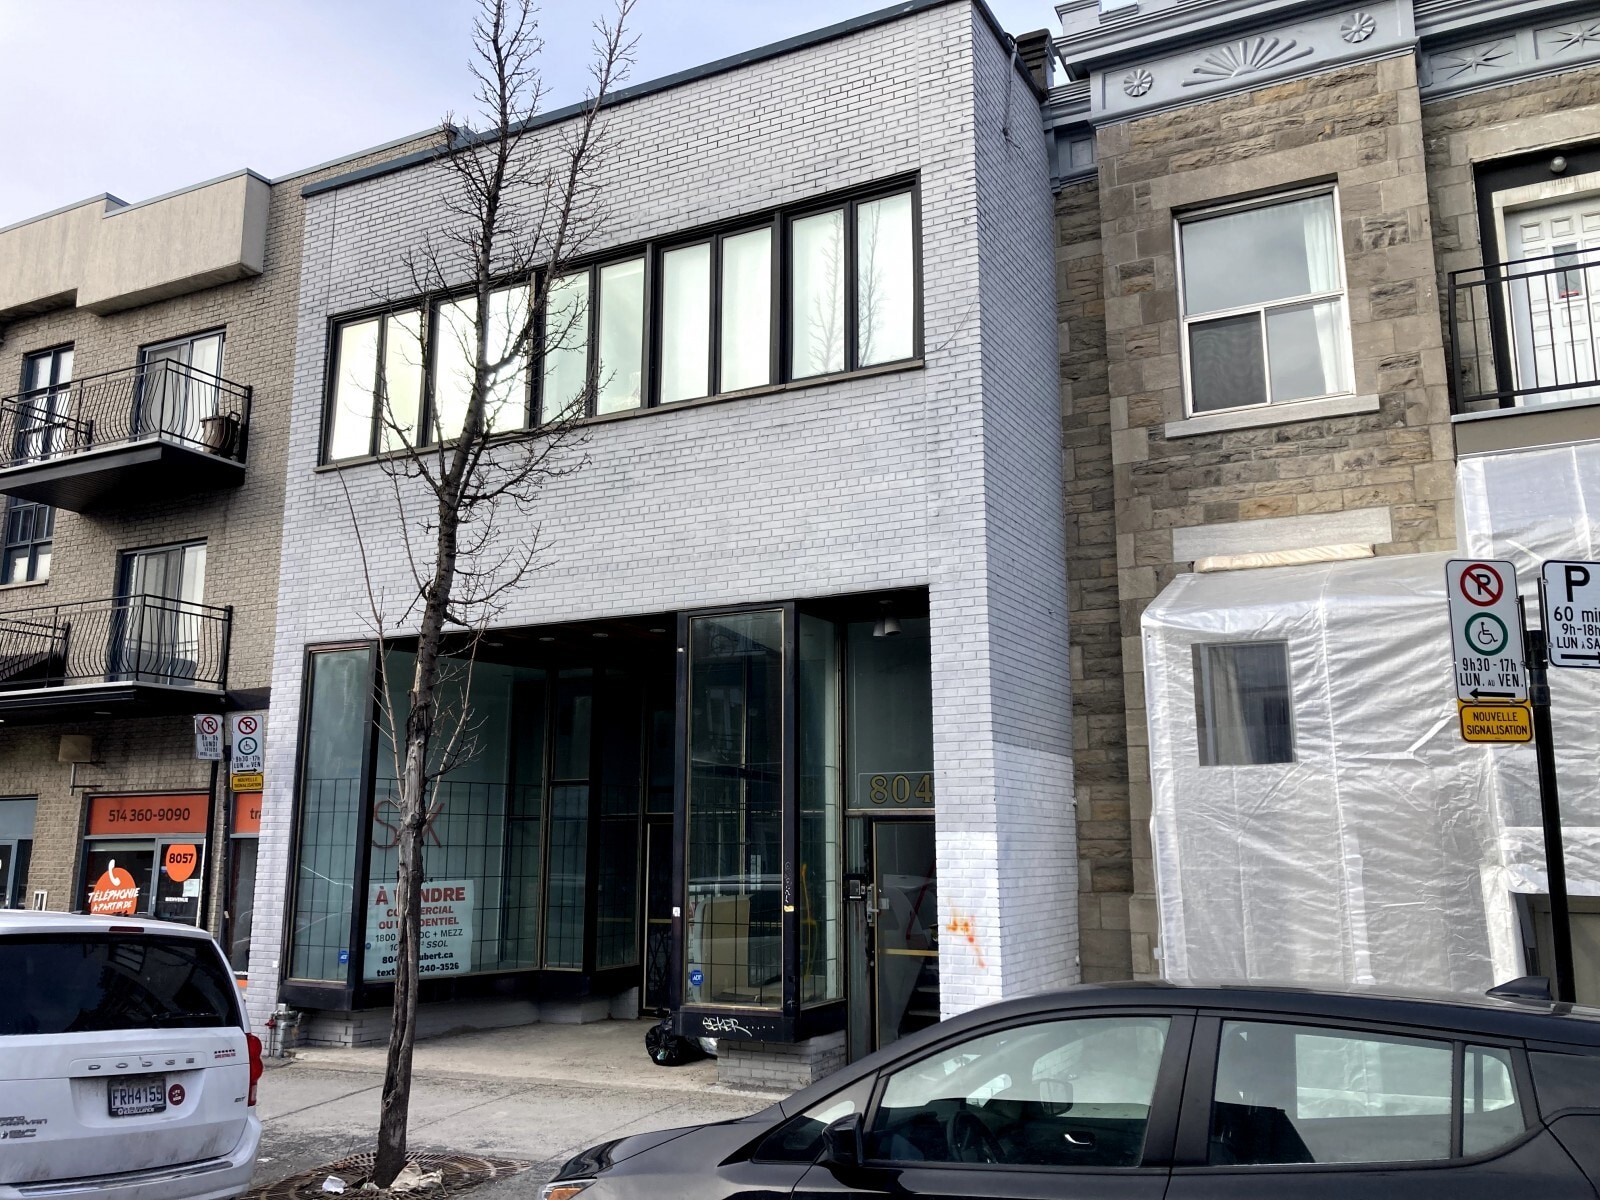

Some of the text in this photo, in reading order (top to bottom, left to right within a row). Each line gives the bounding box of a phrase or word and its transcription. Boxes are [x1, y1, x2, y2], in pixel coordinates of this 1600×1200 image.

[1564, 565, 1590, 602] P
[1554, 606, 1600, 622] 60 mi
[1562, 623, 1600, 636] 9h-18h
[1556, 636, 1578, 649] LUN
[1462, 657, 1490, 672] 9h30
[1500, 658, 1517, 672] 17h
[1460, 672, 1485, 687] LUN.
[1498, 673, 1524, 688] VEN.
[1472, 711, 1519, 722] NOUVELLE
[1466, 725, 1528, 736] SIGNALISATION
[869, 774, 933, 804] 804
[108, 808, 191, 822] 514 360-9090
[168, 853, 194, 864] 8057
[88, 887, 141, 904] TÉLÉPHONIE
[375, 886, 466, 905] À NDRE
[98, 901, 124, 912] PARTIR
[123, 900, 133, 909] DE
[387, 905, 454, 917] COERCIAL
[378, 921, 394, 930] OU
[375, 934, 396, 942] 1800
[440, 928, 464, 938] MEZZ
[426, 940, 449, 949] SSOL
[87, 1057, 195, 1071] DODGE
[112, 1085, 163, 1107] FRH4159
